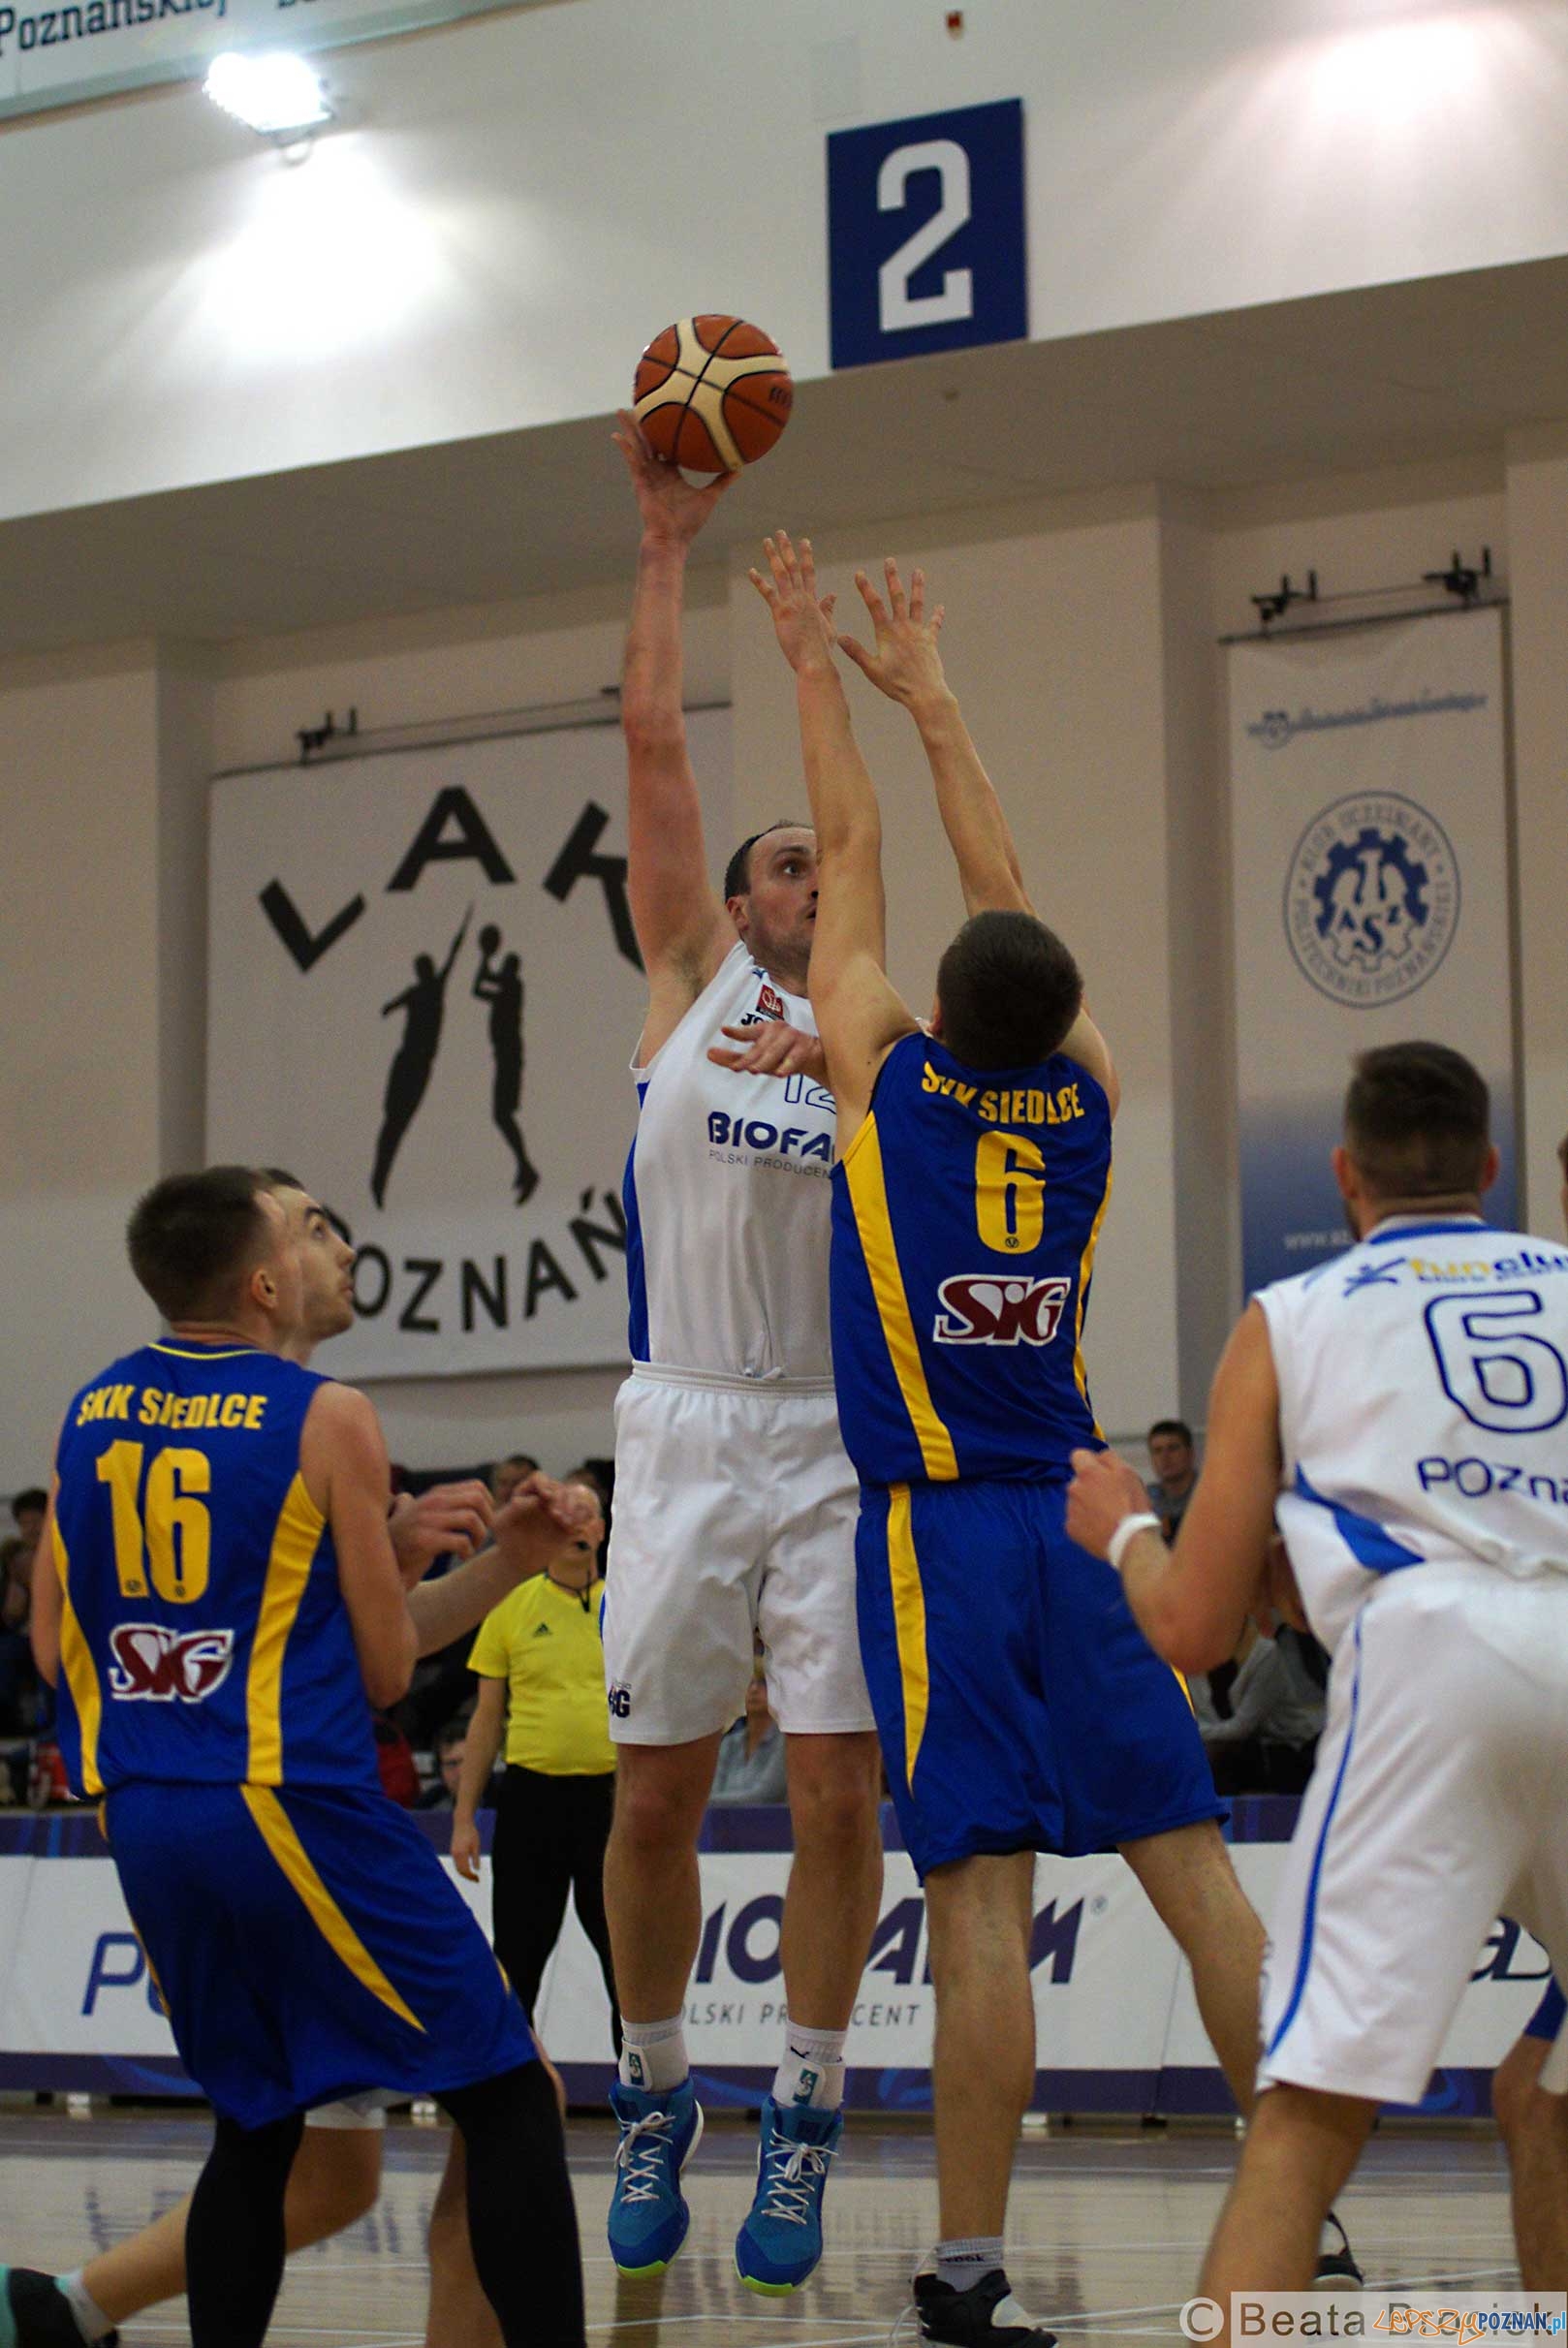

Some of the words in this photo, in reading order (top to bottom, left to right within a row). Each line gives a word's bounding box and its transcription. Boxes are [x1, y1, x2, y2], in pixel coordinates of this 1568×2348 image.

[877, 139, 973, 333] 2
[707, 1111, 835, 1163] BIOFA
[708, 1149, 748, 1165] POLSKI
[754, 1156, 831, 1178] PRODUCEN
[978, 1082, 1086, 1125] SIEDLCE
[975, 1129, 1047, 1255] 6
[322, 1185, 628, 1333] OZNAŃ
[77, 1384, 136, 1426] SKK
[138, 1387, 267, 1429] SIEDLCE
[1424, 1290, 1568, 1433] 6
[96, 1439, 211, 1604] 16
